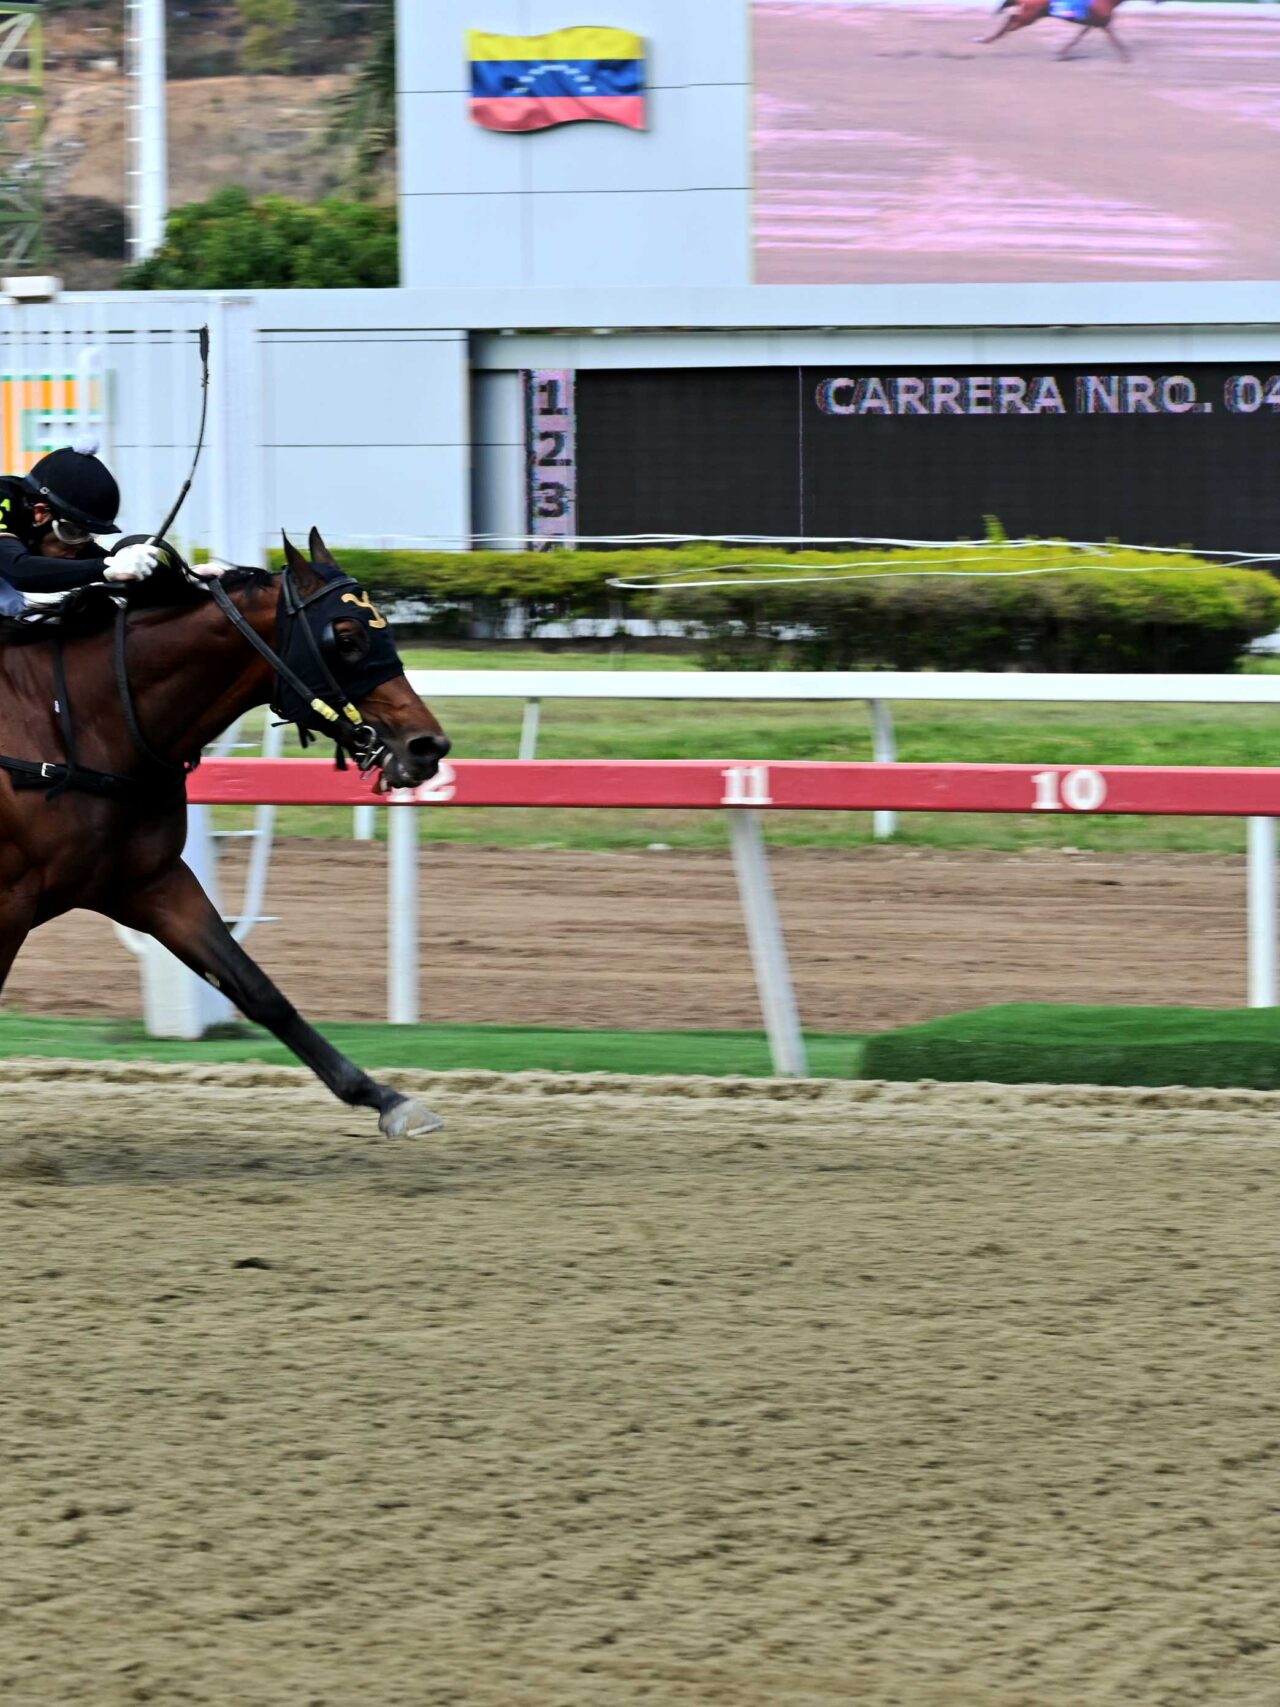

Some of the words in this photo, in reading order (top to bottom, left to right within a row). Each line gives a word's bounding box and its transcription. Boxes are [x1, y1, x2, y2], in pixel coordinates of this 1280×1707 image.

[538, 379, 568, 416] 1
[817, 376, 1066, 415] CARRERA
[1076, 375, 1214, 414] NRO.
[538, 430, 572, 467] 2
[536, 481, 570, 518] 3
[386, 763, 457, 803] 2
[720, 766, 773, 805] 11
[1030, 768, 1108, 810] 10
